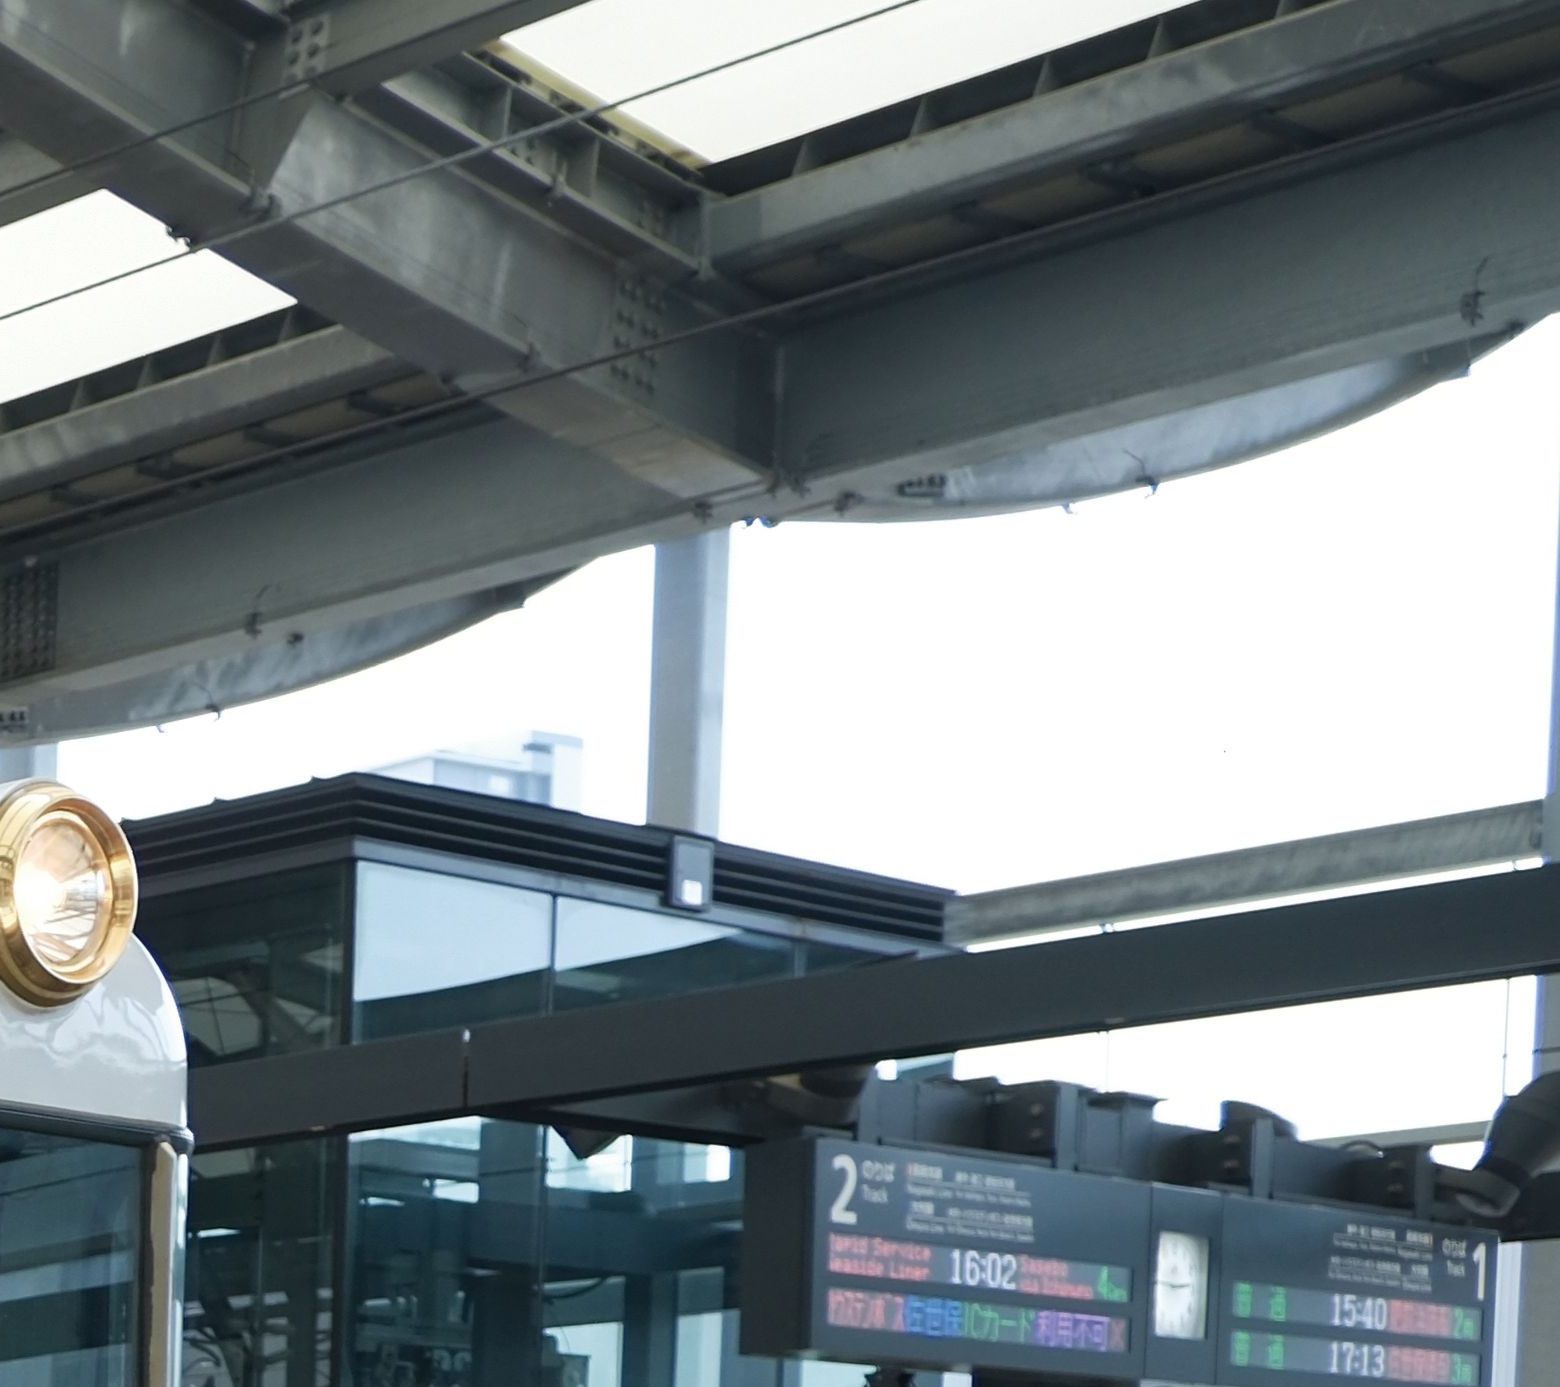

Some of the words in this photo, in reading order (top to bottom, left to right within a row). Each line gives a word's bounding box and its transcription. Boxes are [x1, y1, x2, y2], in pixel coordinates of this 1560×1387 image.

[831, 1154, 858, 1225] 2
[951, 1248, 1018, 1290] 16:02
[1472, 1242, 1486, 1301] 1
[1331, 1293, 1387, 1331] 15:40
[1329, 1341, 1385, 1377] 17:13
